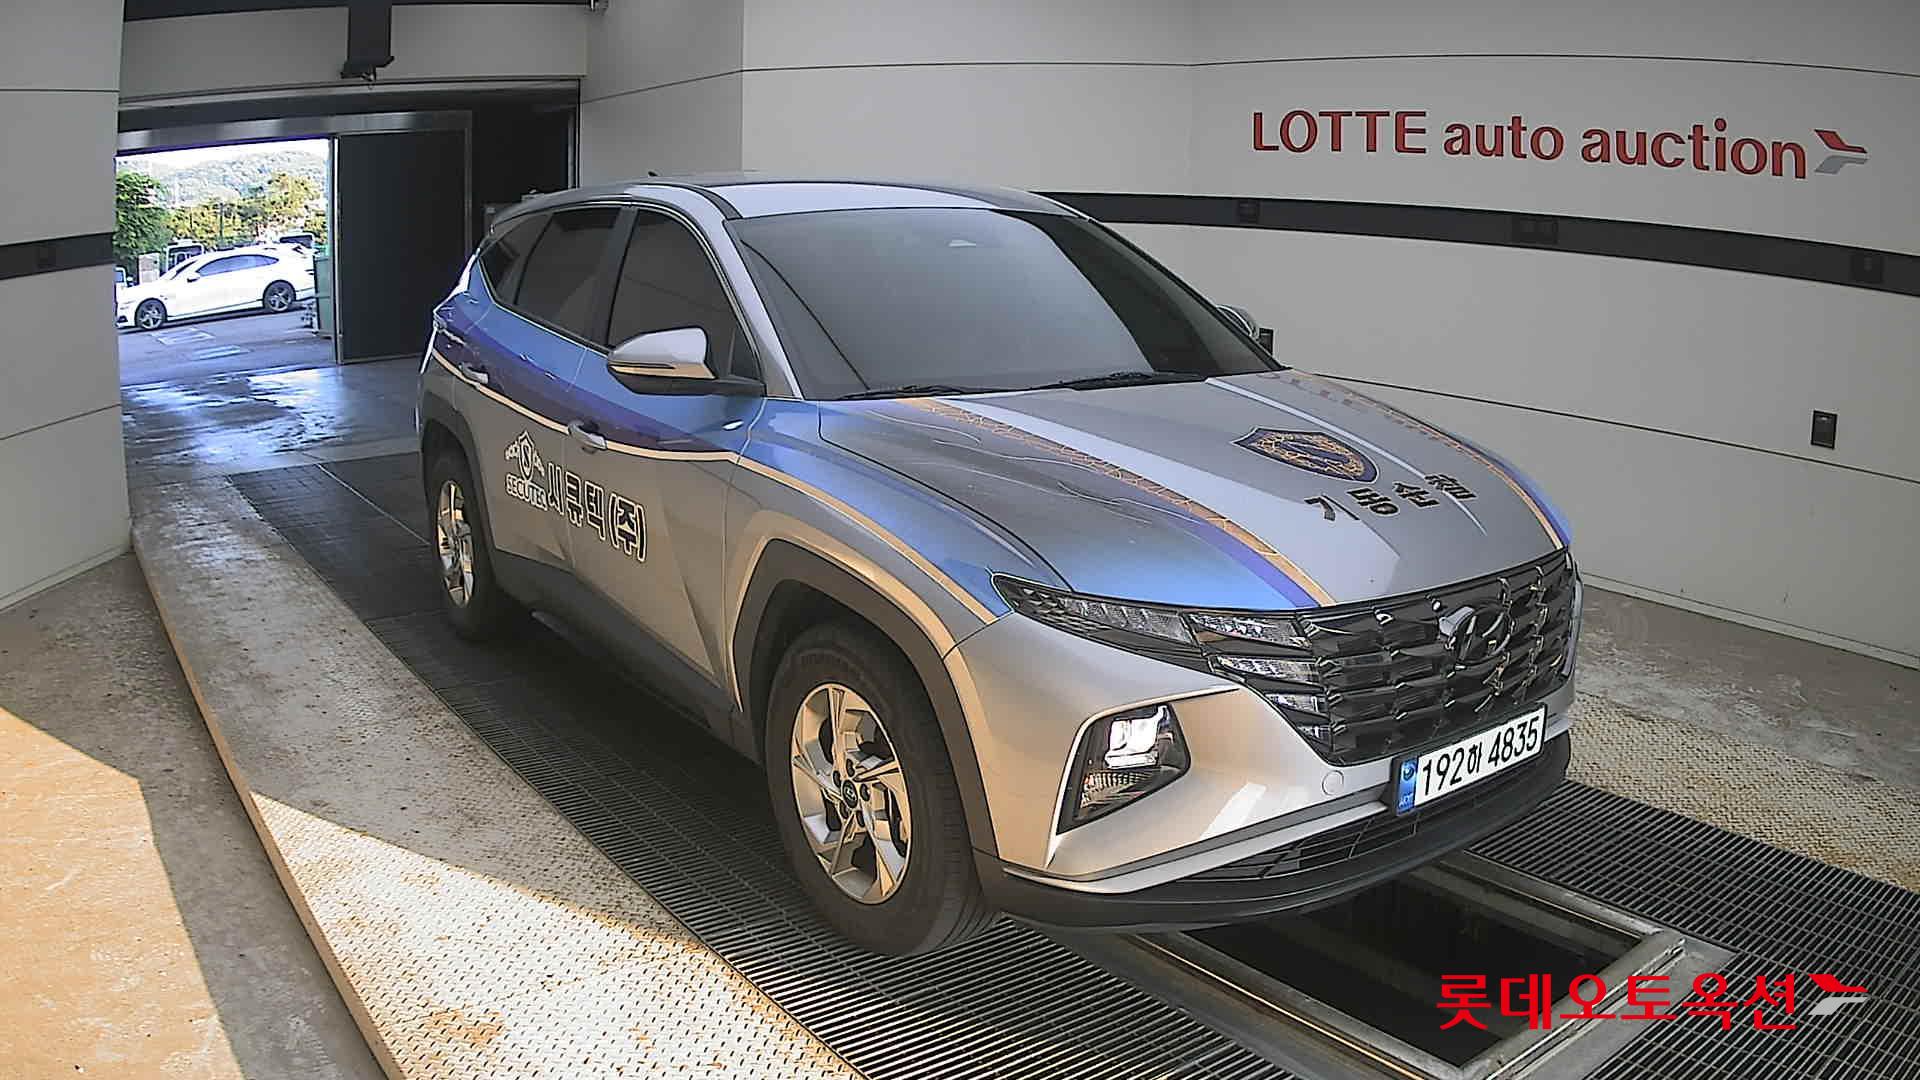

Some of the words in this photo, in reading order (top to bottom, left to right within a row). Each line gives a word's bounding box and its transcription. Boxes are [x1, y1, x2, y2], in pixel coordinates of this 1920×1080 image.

[1252, 110, 1428, 155] LOTTE
[1443, 115, 1566, 162] auto
[1580, 117, 1808, 180] auction
[547, 461, 646, 563] 시큐텍(주)
[1422, 741, 1483, 796] 192하
[1487, 715, 1540, 768] 4835
